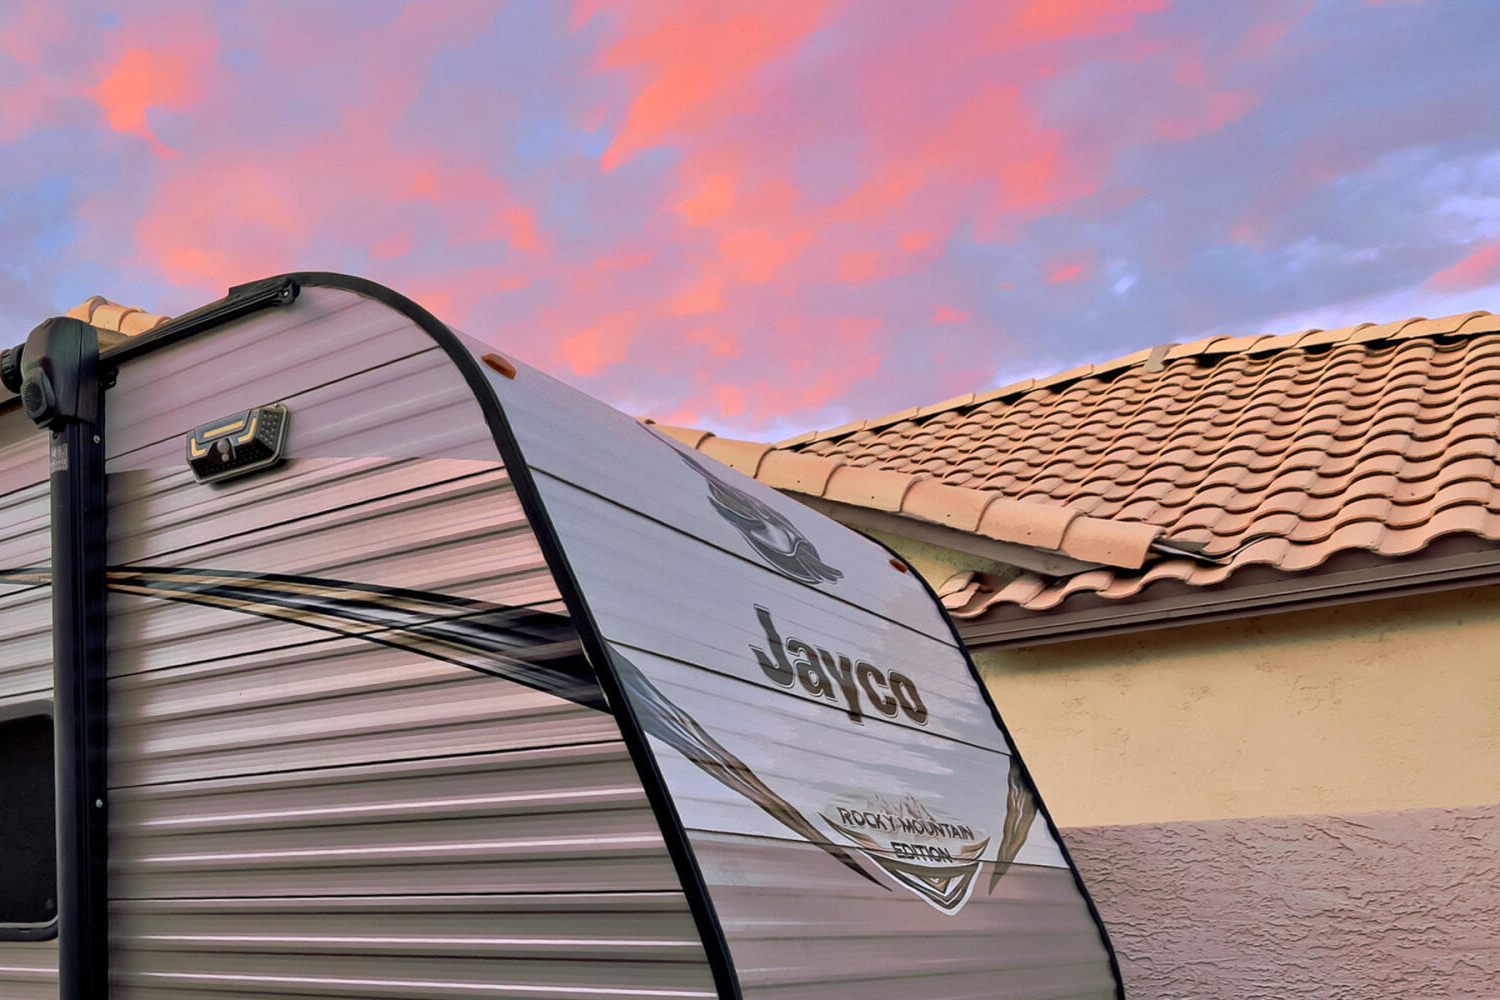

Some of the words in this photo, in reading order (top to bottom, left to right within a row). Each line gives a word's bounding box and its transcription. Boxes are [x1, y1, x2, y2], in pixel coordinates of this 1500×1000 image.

[748, 603, 929, 726] Jayco
[836, 806, 896, 832] ROCKY
[898, 816, 975, 841] MOUNTAIN
[890, 841, 954, 863] EDITION
